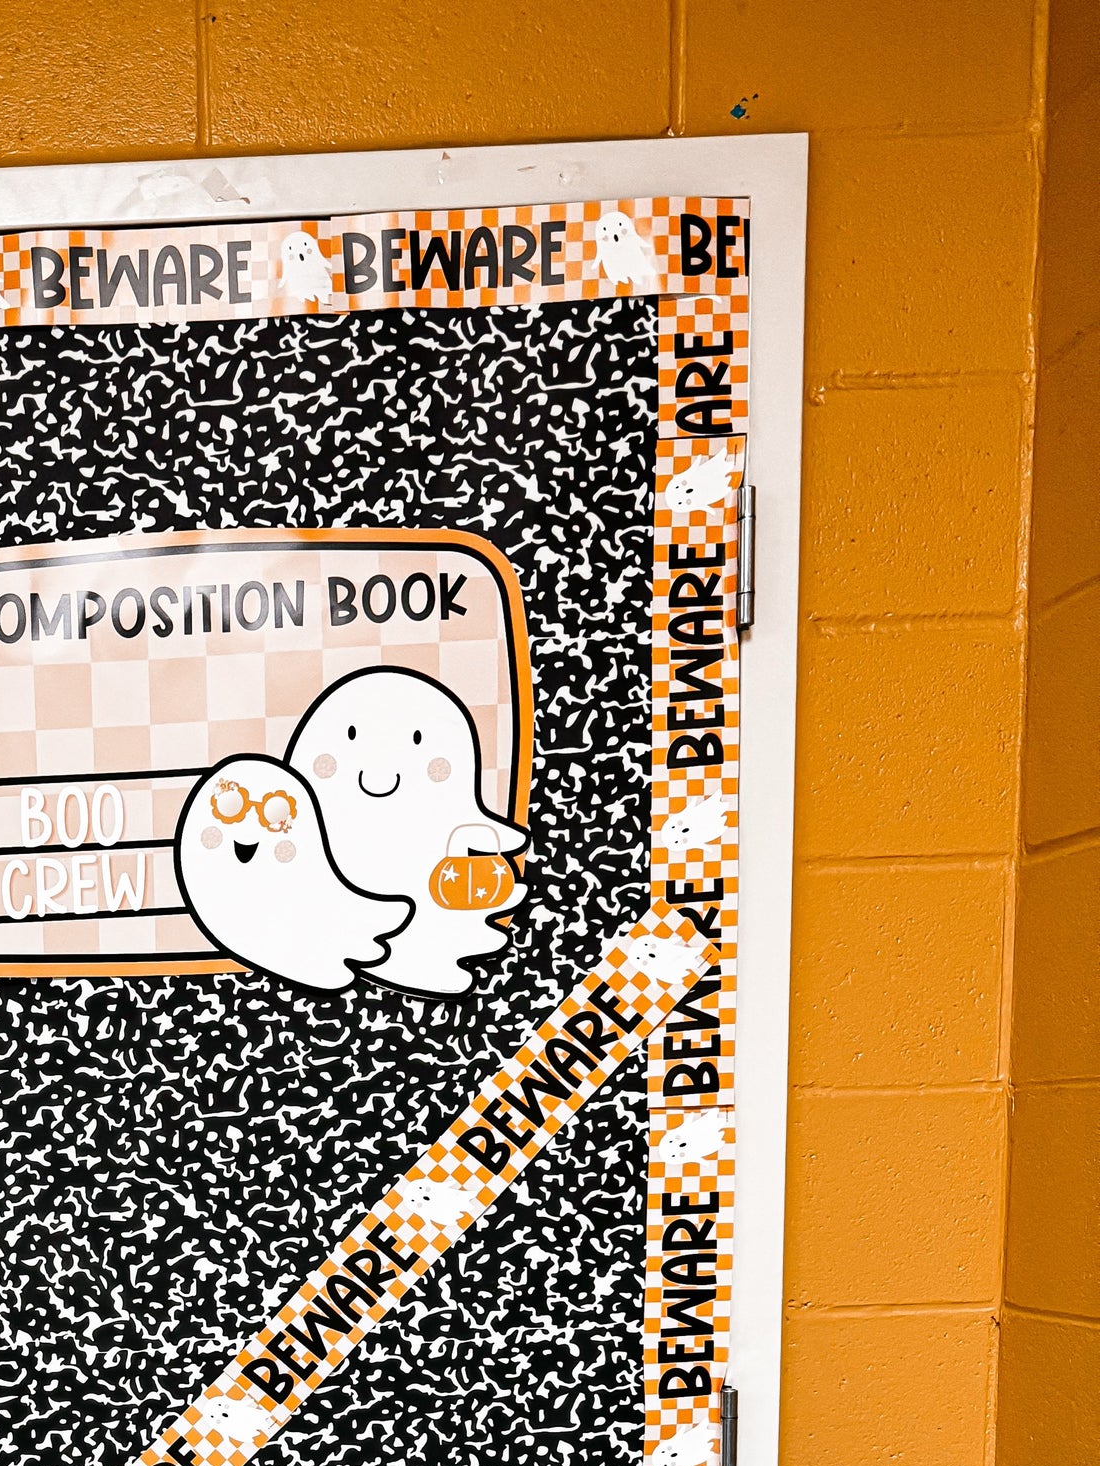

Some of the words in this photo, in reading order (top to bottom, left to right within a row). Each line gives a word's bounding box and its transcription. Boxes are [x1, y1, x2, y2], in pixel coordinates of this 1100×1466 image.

[31, 241, 251, 309] BEWARE
[342, 220, 567, 294] BEWARE
[680, 213, 750, 278] BE
[330, 572, 468, 625] BOOK
[666, 543, 725, 770] BEWARE
[2, 852, 146, 920] CREW
[20, 784, 124, 849] BOO
[456, 981, 645, 1175] BEWARE
[663, 878, 724, 1097] BEWRE
[241, 1221, 421, 1404] BEWARE
[659, 1192, 719, 1399] BEWARE
